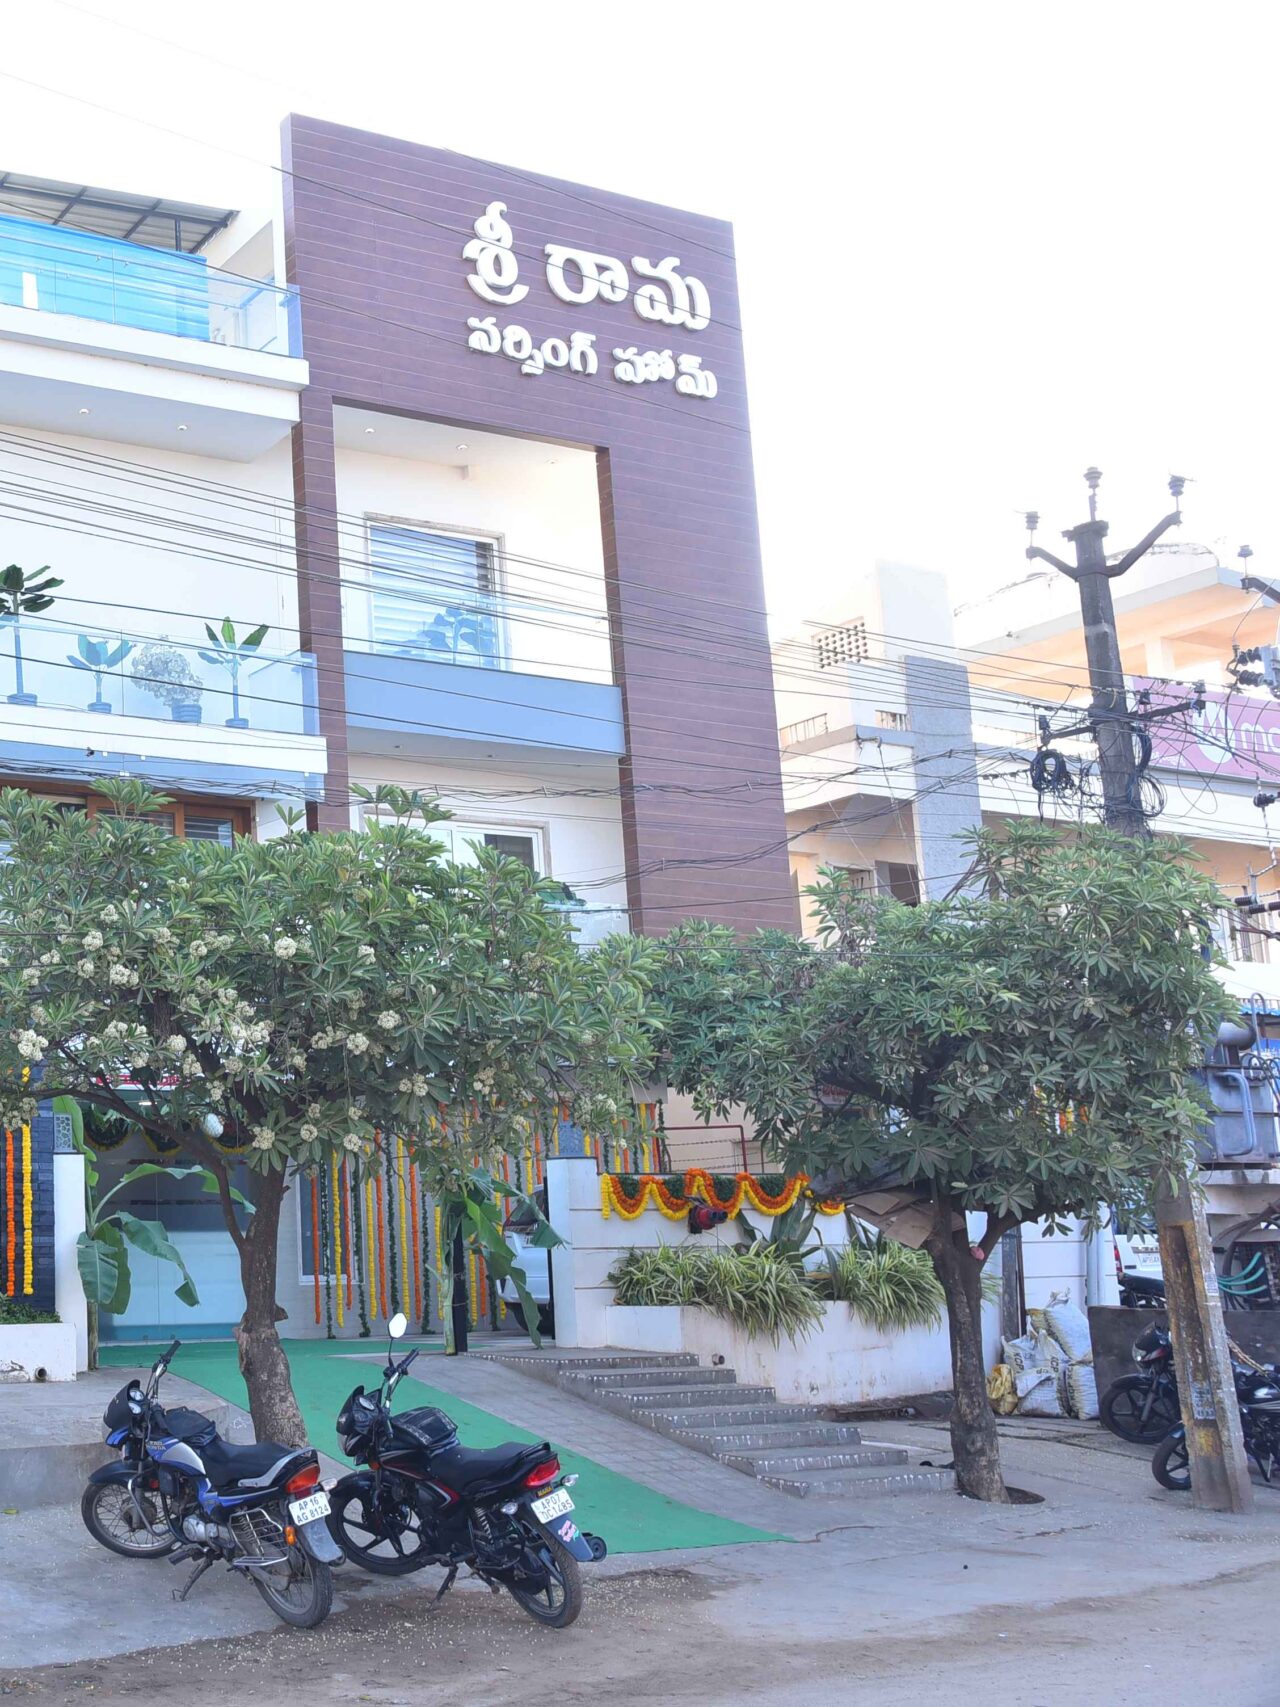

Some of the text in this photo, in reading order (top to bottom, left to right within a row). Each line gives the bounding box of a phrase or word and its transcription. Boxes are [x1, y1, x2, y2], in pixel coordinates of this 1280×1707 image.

[462, 200, 712, 332] శ్రీ రామ
[466, 316, 718, 399] నర్సింగ్ హోమ్
[296, 1503, 329, 1524] AG 8124
[298, 1496, 320, 1512] AP 16
